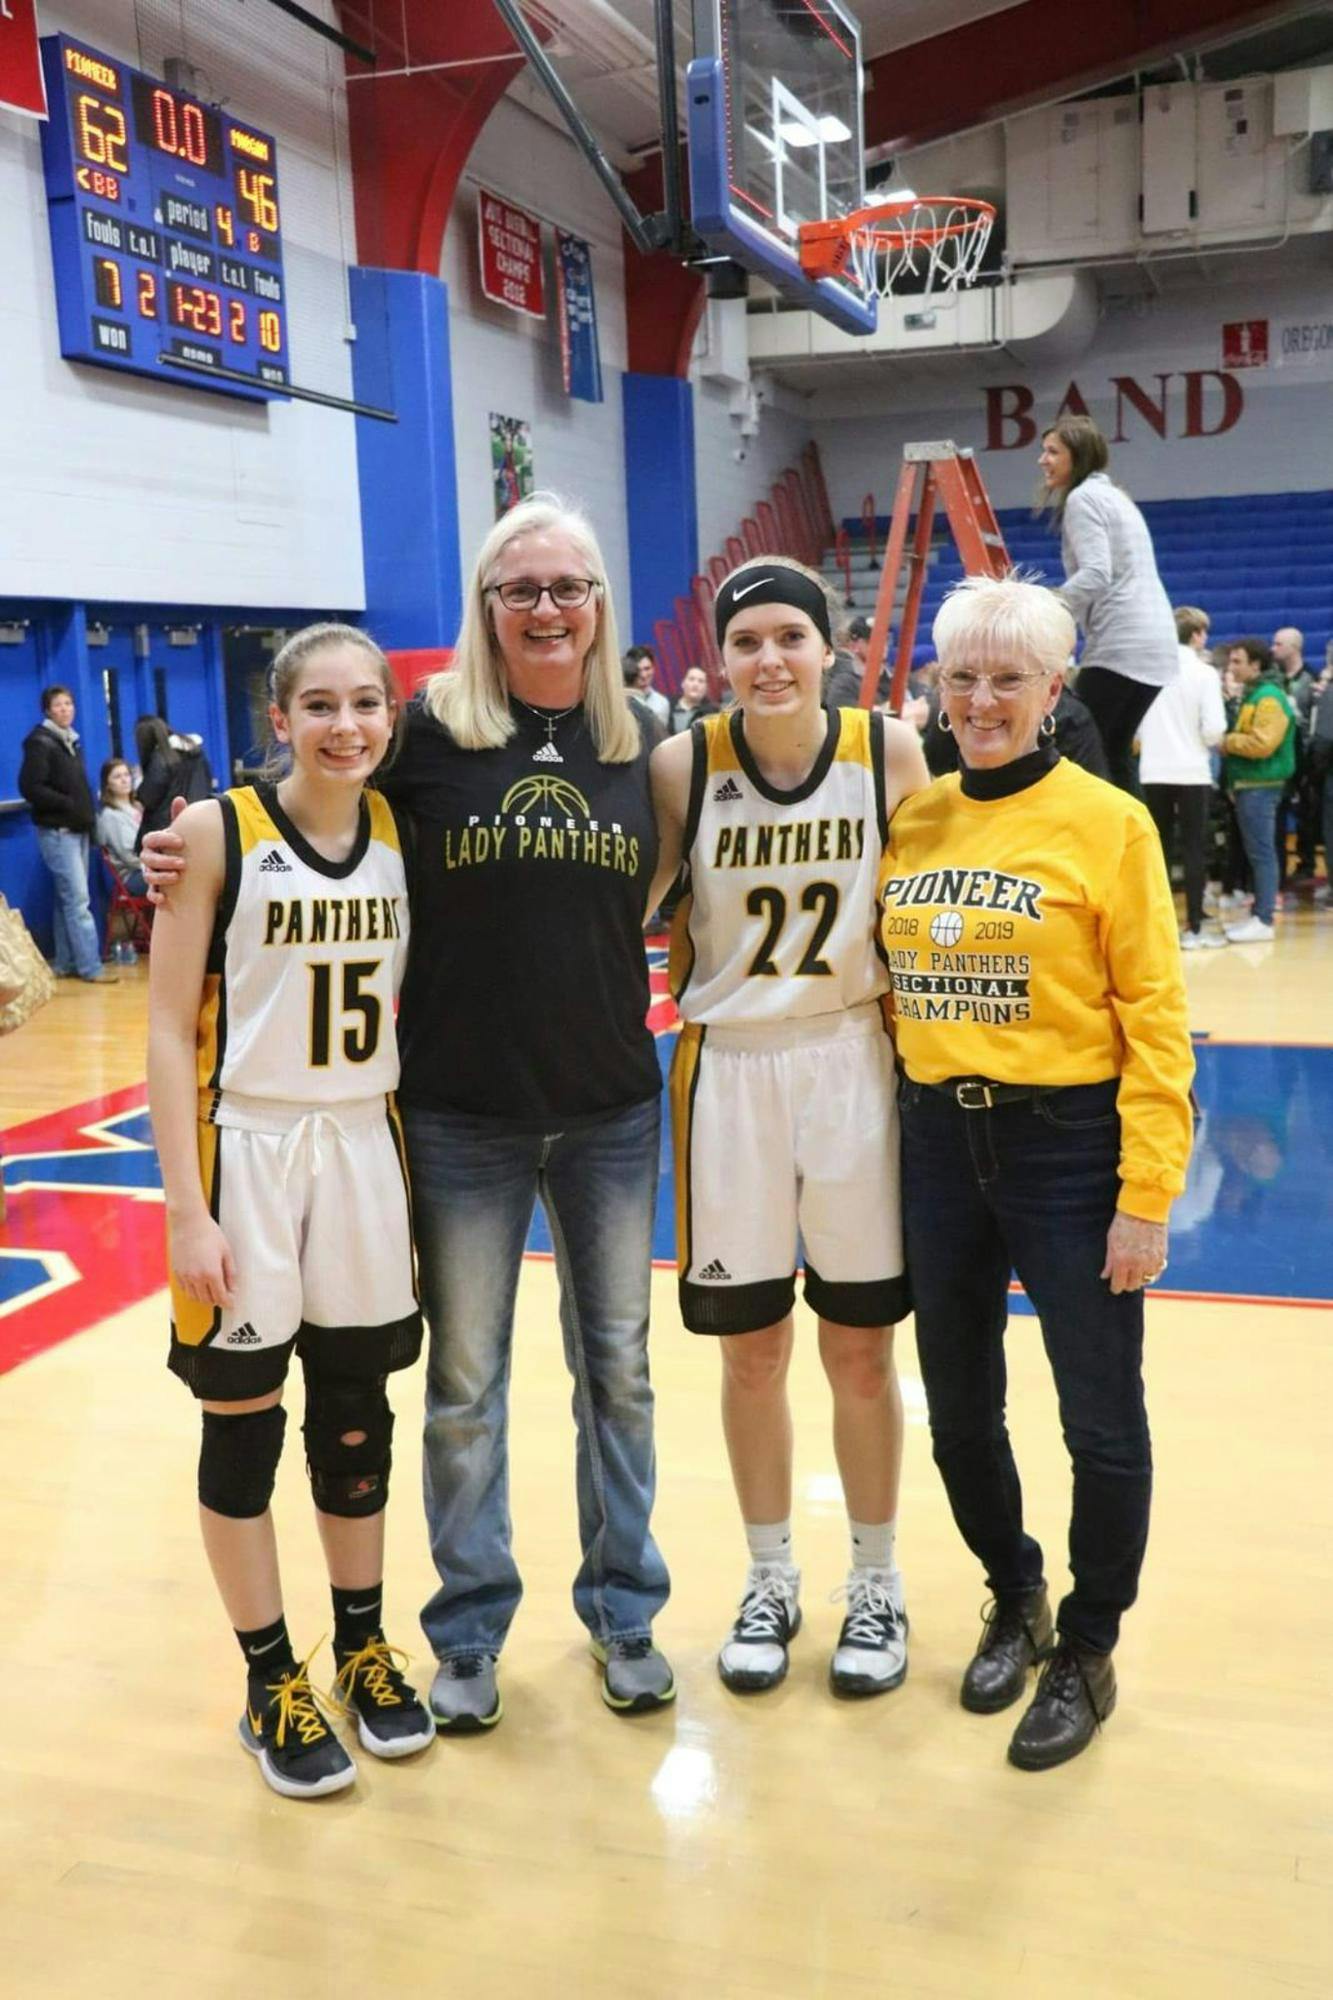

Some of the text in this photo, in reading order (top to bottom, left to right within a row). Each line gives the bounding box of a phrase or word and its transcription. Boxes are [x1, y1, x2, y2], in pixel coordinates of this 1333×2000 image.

[80, 95, 127, 172] 62
[153, 89, 206, 166] 0.0
[167, 199, 208, 232] period
[239, 169, 278, 232] 46
[86, 211, 121, 248] fouls
[216, 206, 233, 245] 4
[170, 241, 211, 276] player
[102, 260, 121, 305] 7
[139, 272, 155, 317] 2
[98, 324, 127, 350] won
[230, 301, 245, 341] 2
[260, 311, 280, 352] 10
[980, 369, 1244, 450] BAND
[532, 753, 564, 763] adidas
[468, 814, 623, 835] PIONEER
[259, 864, 293, 873] adidas
[445, 826, 640, 877] LADY PANTHERS
[883, 868, 1043, 921] PIONEER
[744, 878, 839, 976] 22
[888, 916, 919, 936] 2018
[975, 921, 1014, 941] 2019
[888, 950, 1030, 975] ADY PANTHERS
[893, 974, 1019, 997] SECTIONAL
[306, 959, 383, 1068] 15
[899, 997, 1031, 1025] HAMPIONS
[699, 1271, 732, 1280] adidas
[227, 1335, 262, 1345] adidas
